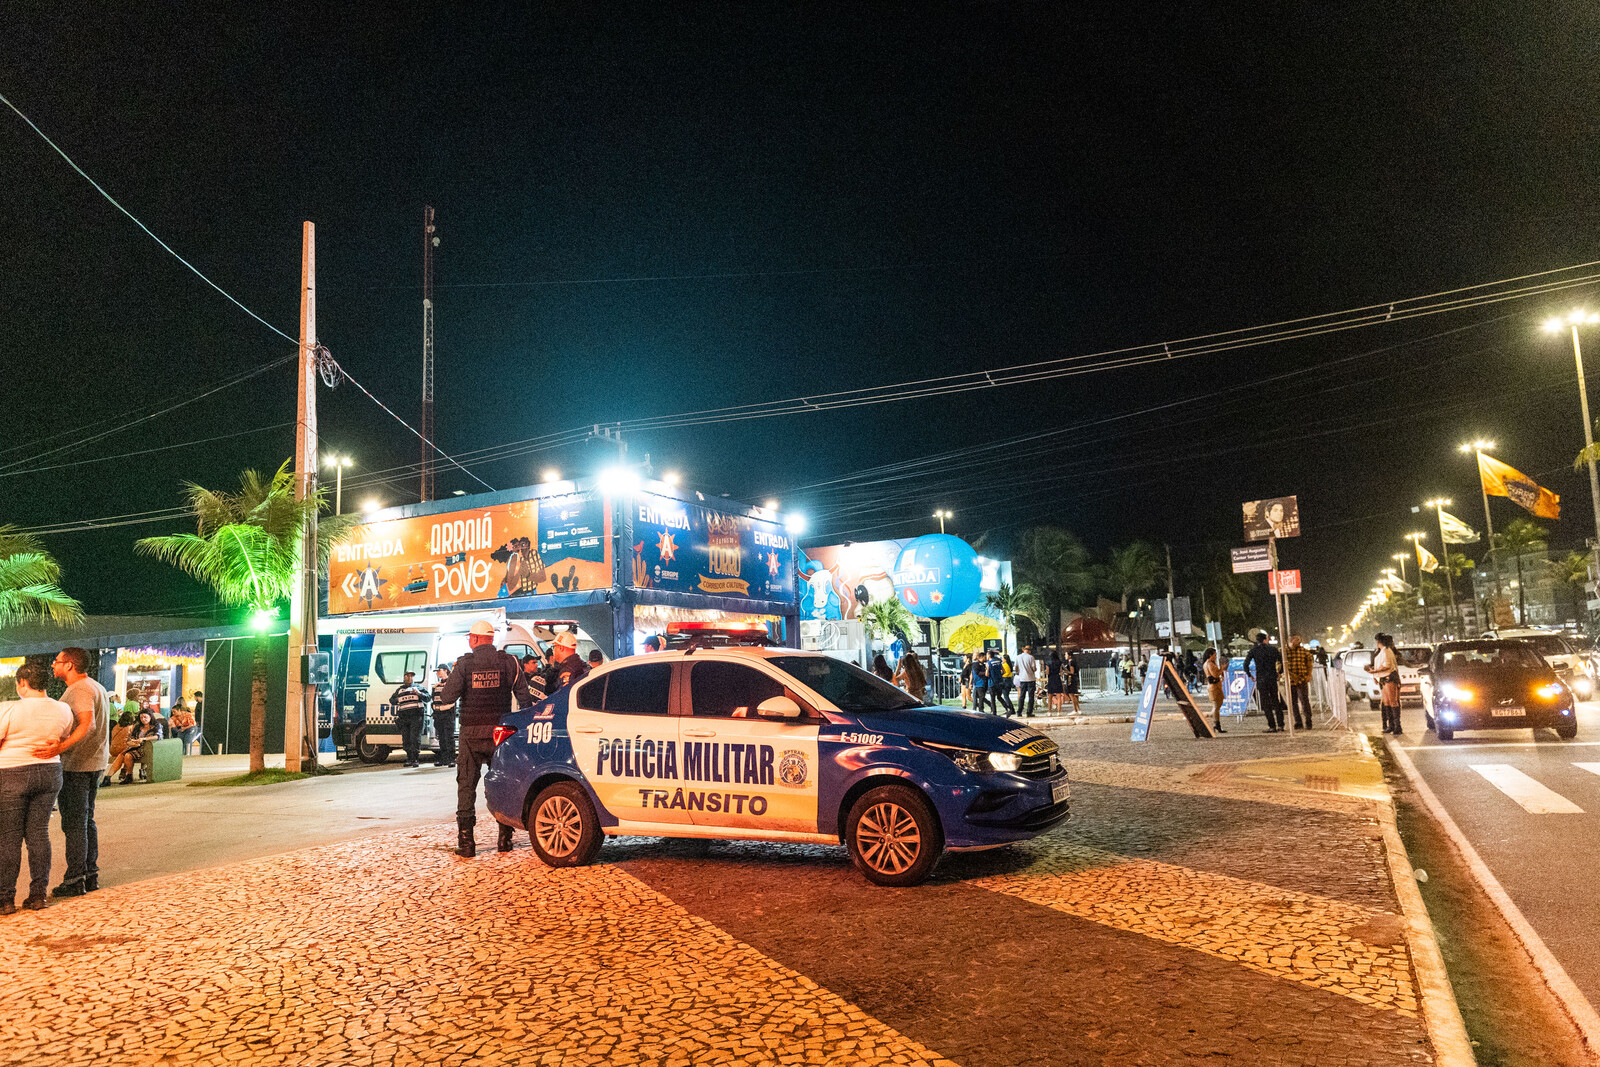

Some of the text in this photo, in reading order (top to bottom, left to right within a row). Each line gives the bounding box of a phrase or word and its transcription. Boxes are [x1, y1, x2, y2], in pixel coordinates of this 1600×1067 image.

[639, 507, 691, 531] ENTRADA
[431, 512, 492, 555] ARRAIÁ
[754, 531, 789, 550] ENTRADA
[338, 539, 405, 562] ENTRADA
[660, 535, 673, 559] A
[452, 555, 460, 564] DO
[709, 546, 741, 577] FORRÓ
[769, 554, 778, 574] A
[360, 567, 379, 597] A
[433, 557, 492, 598] POVO
[906, 590, 917, 602] A
[473, 680, 500, 688] MILITAR
[526, 721, 553, 744] 190
[840, 731, 884, 745] E-51002
[597, 735, 678, 780] POLÍCIA
[684, 741, 775, 785] MILITAR
[639, 787, 768, 816] TRÂNSITO
